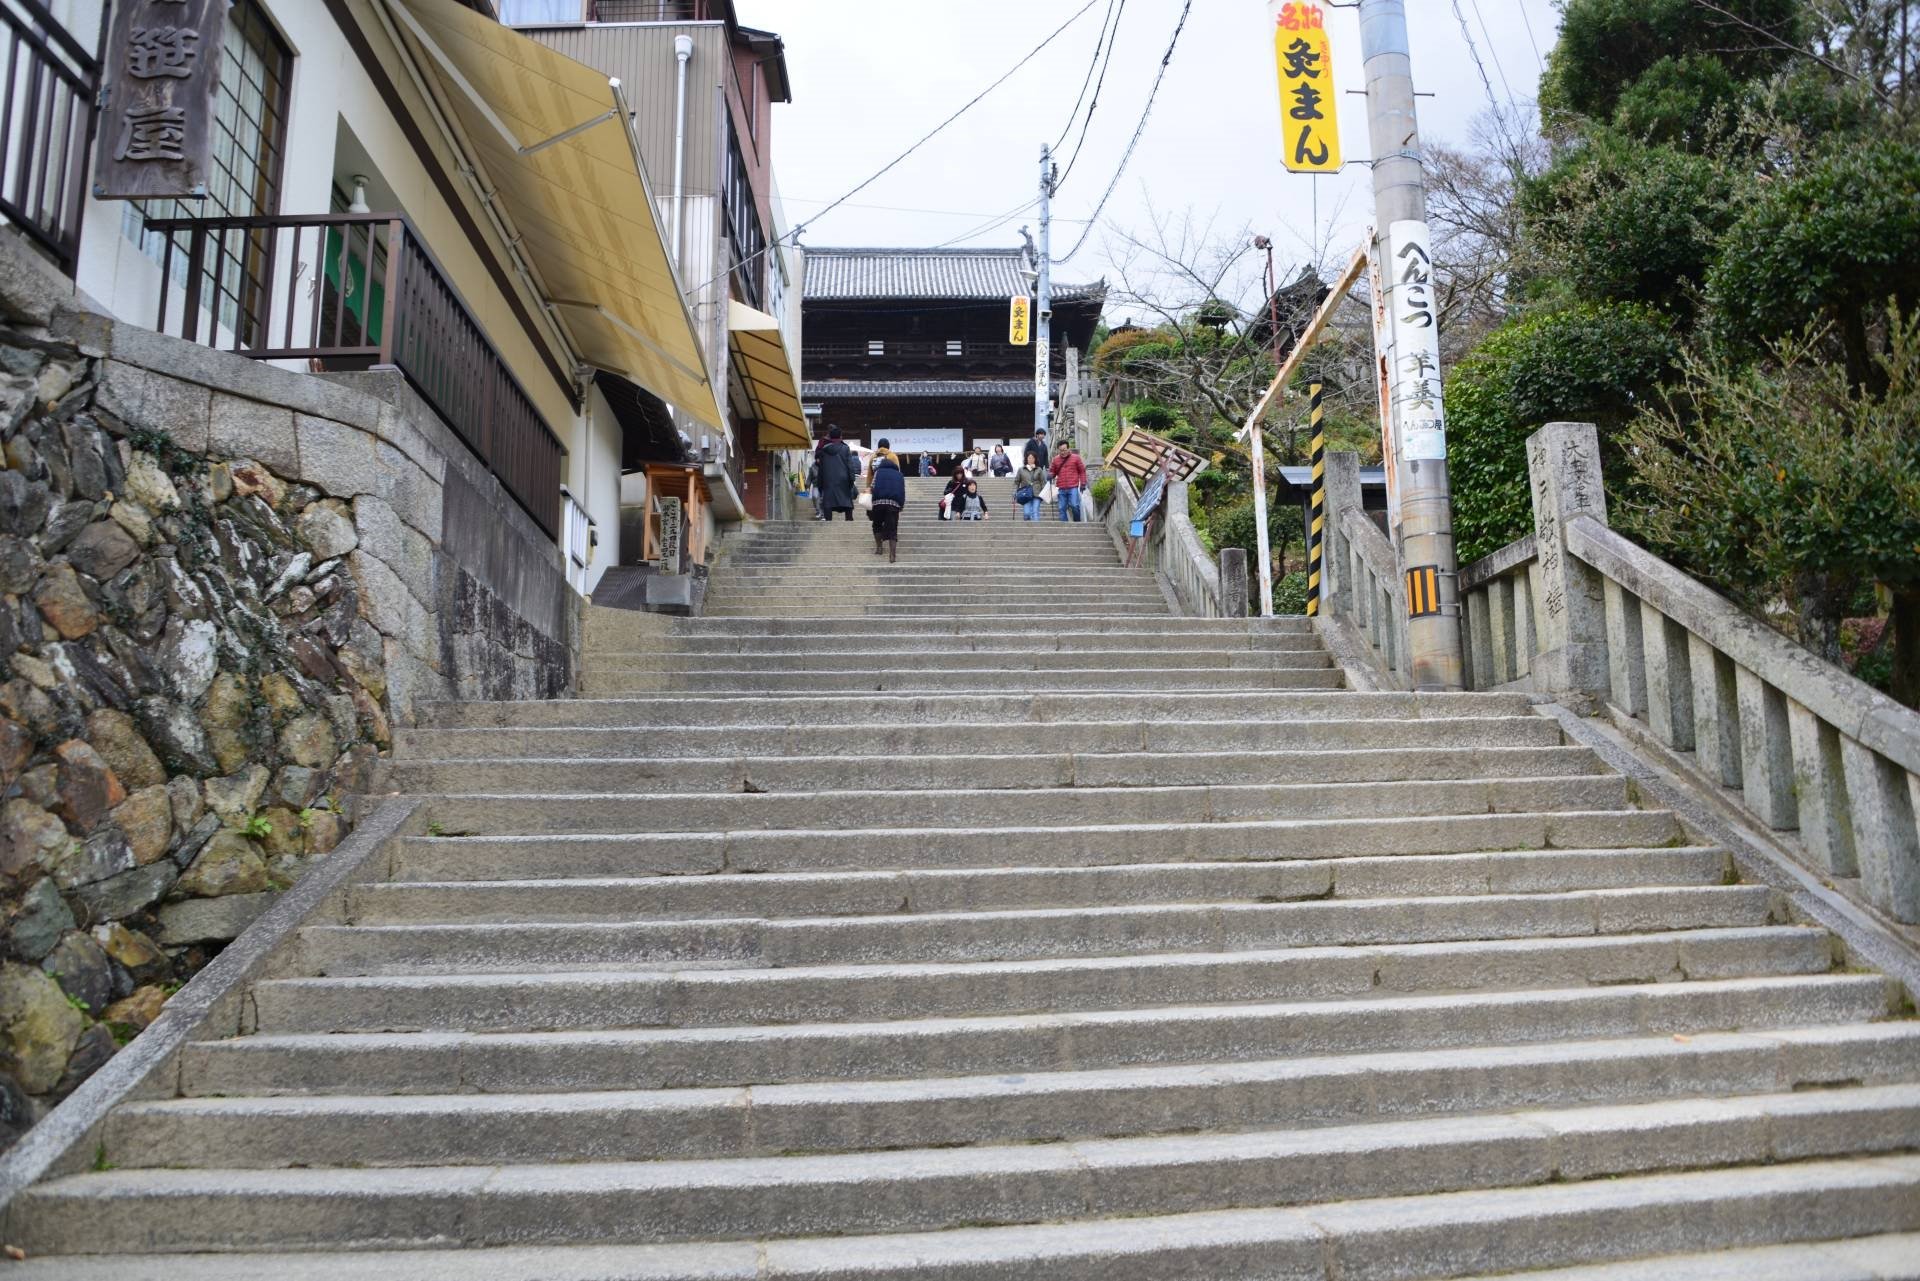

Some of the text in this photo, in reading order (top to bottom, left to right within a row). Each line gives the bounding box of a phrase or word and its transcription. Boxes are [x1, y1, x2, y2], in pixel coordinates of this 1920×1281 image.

[1276, 2, 1323, 31] 名物
[113, 0, 199, 161] 笹屋
[1283, 37, 1329, 166] 灸まん
[1013, 306, 1024, 341] 灸まん
